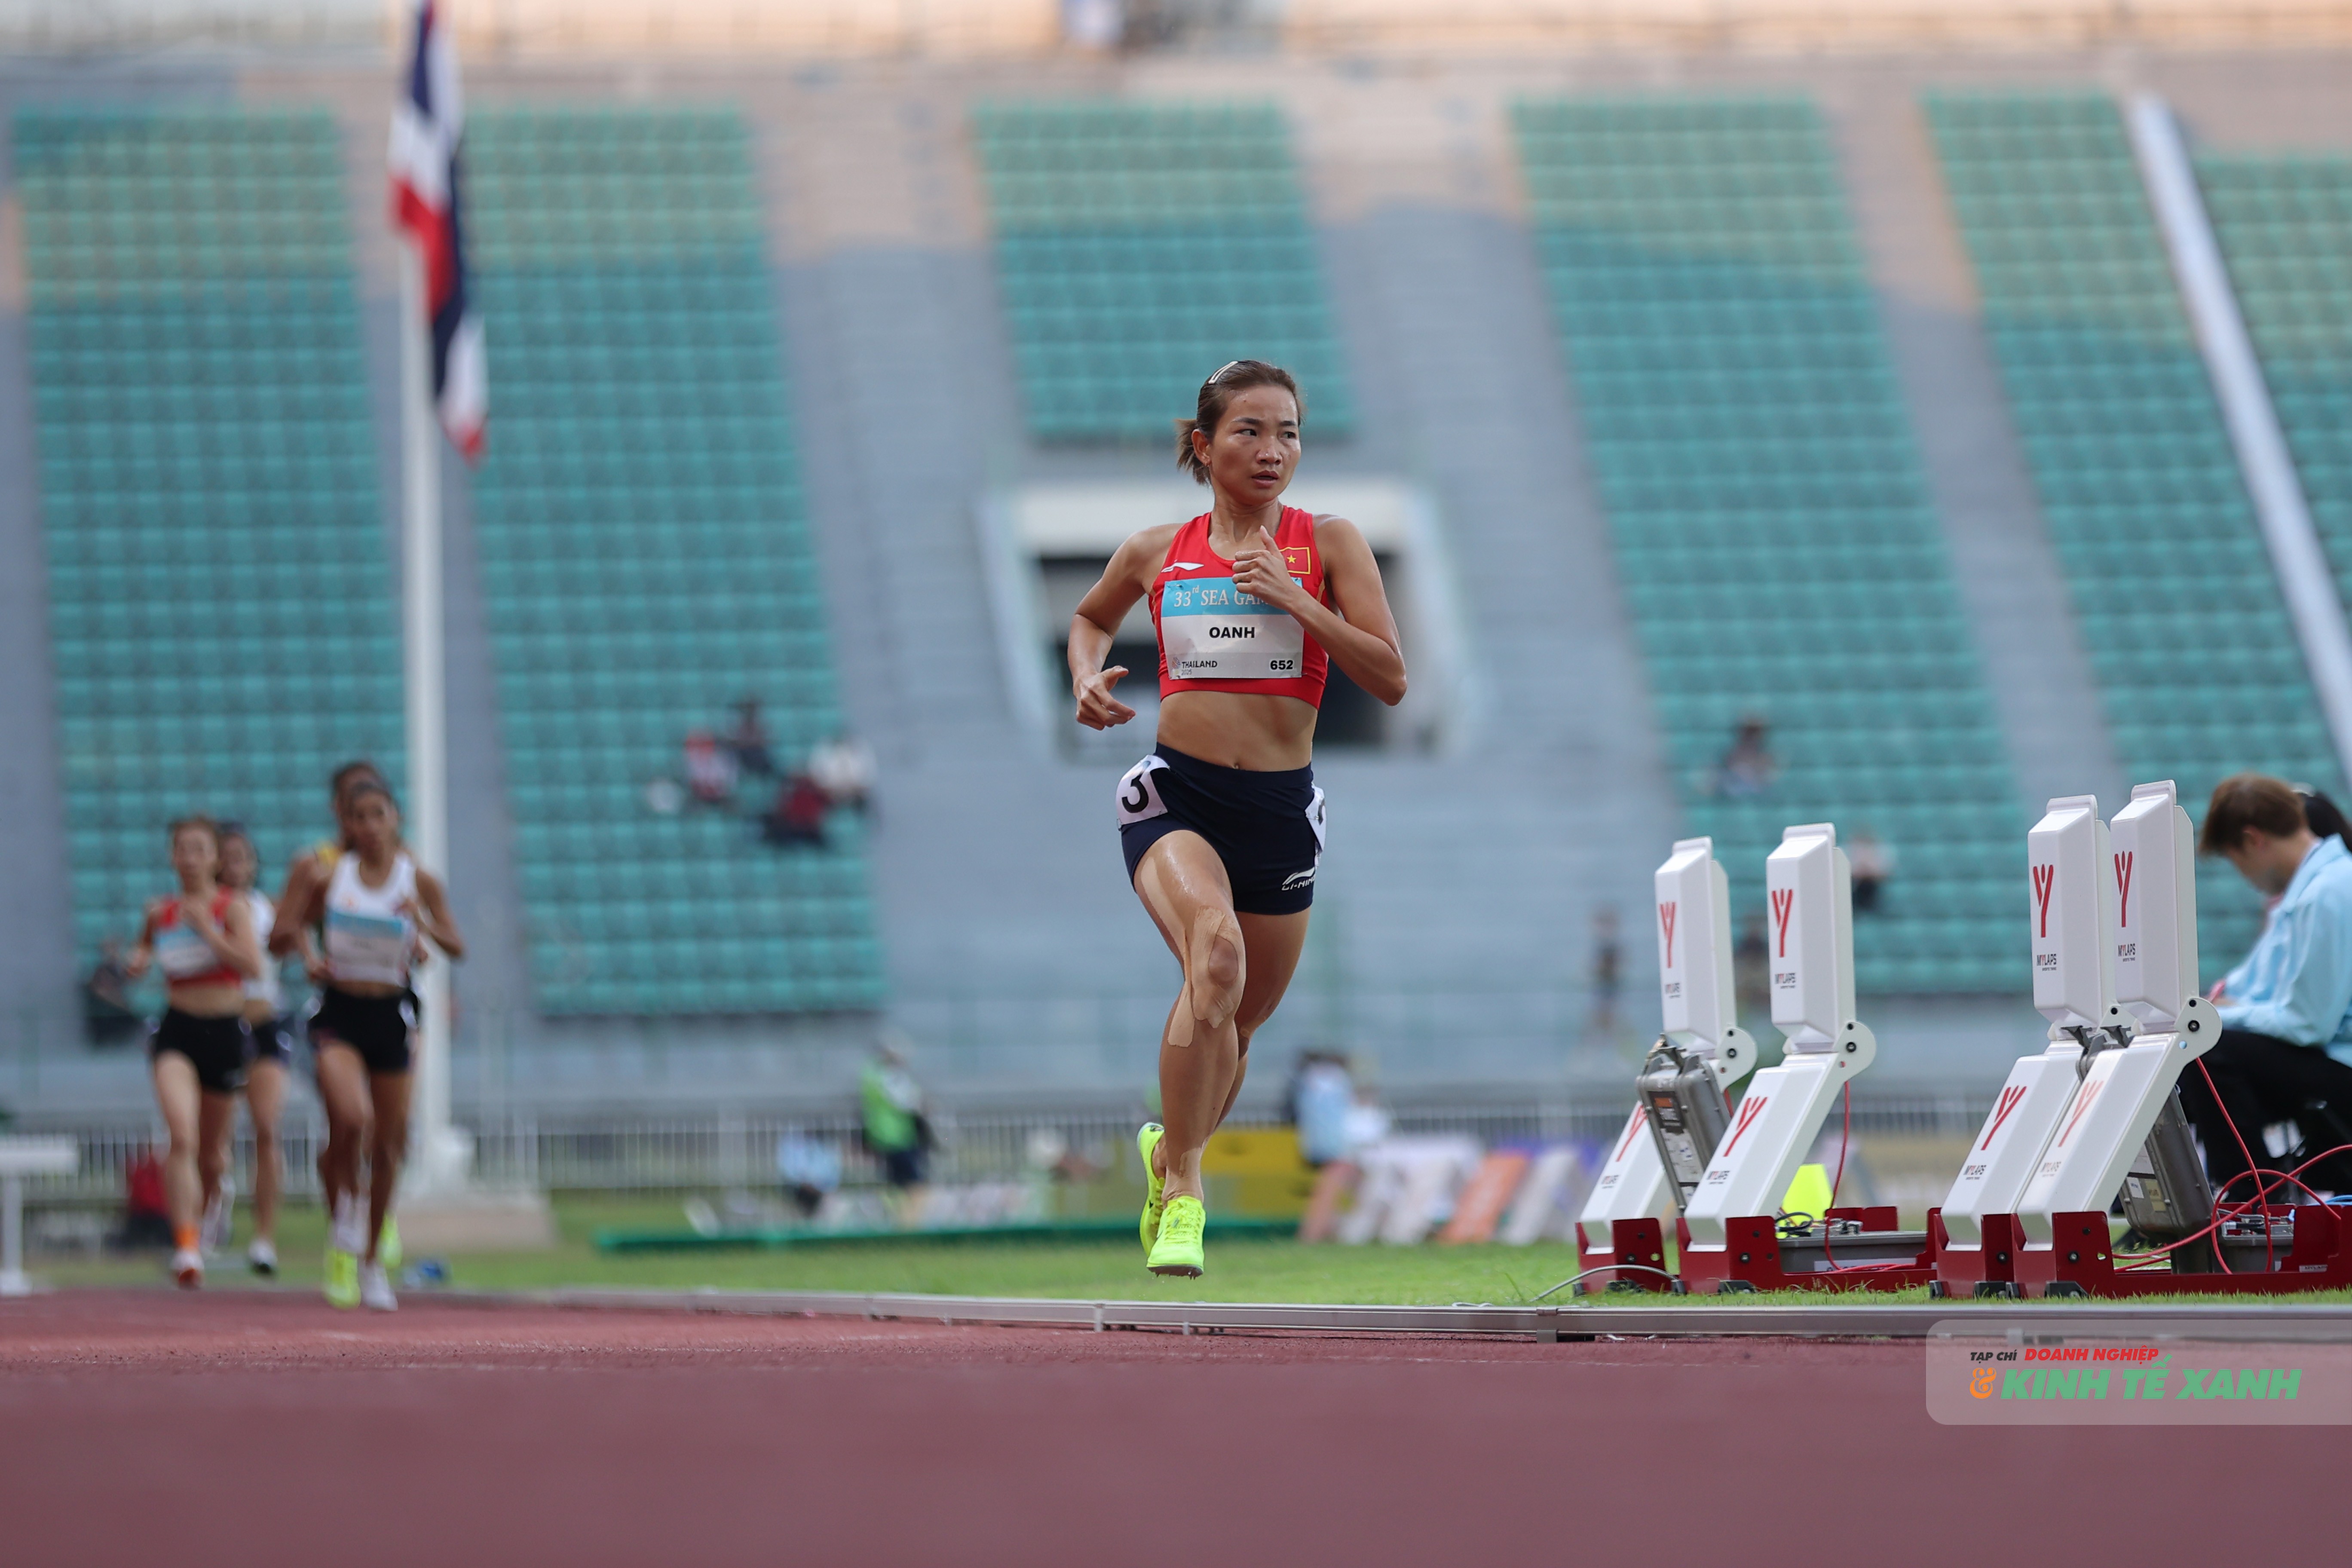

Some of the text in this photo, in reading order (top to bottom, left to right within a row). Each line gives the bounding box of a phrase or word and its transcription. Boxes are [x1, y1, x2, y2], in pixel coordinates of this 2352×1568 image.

[1200, 589, 1229, 606] SEA
[1209, 627, 1255, 639] OANH
[1182, 660, 1218, 669] THAILAND
[1270, 660, 1293, 671] 652
[2118, 943, 2136, 957] MYLAPS
[2037, 953, 2057, 966] MYLAPS
